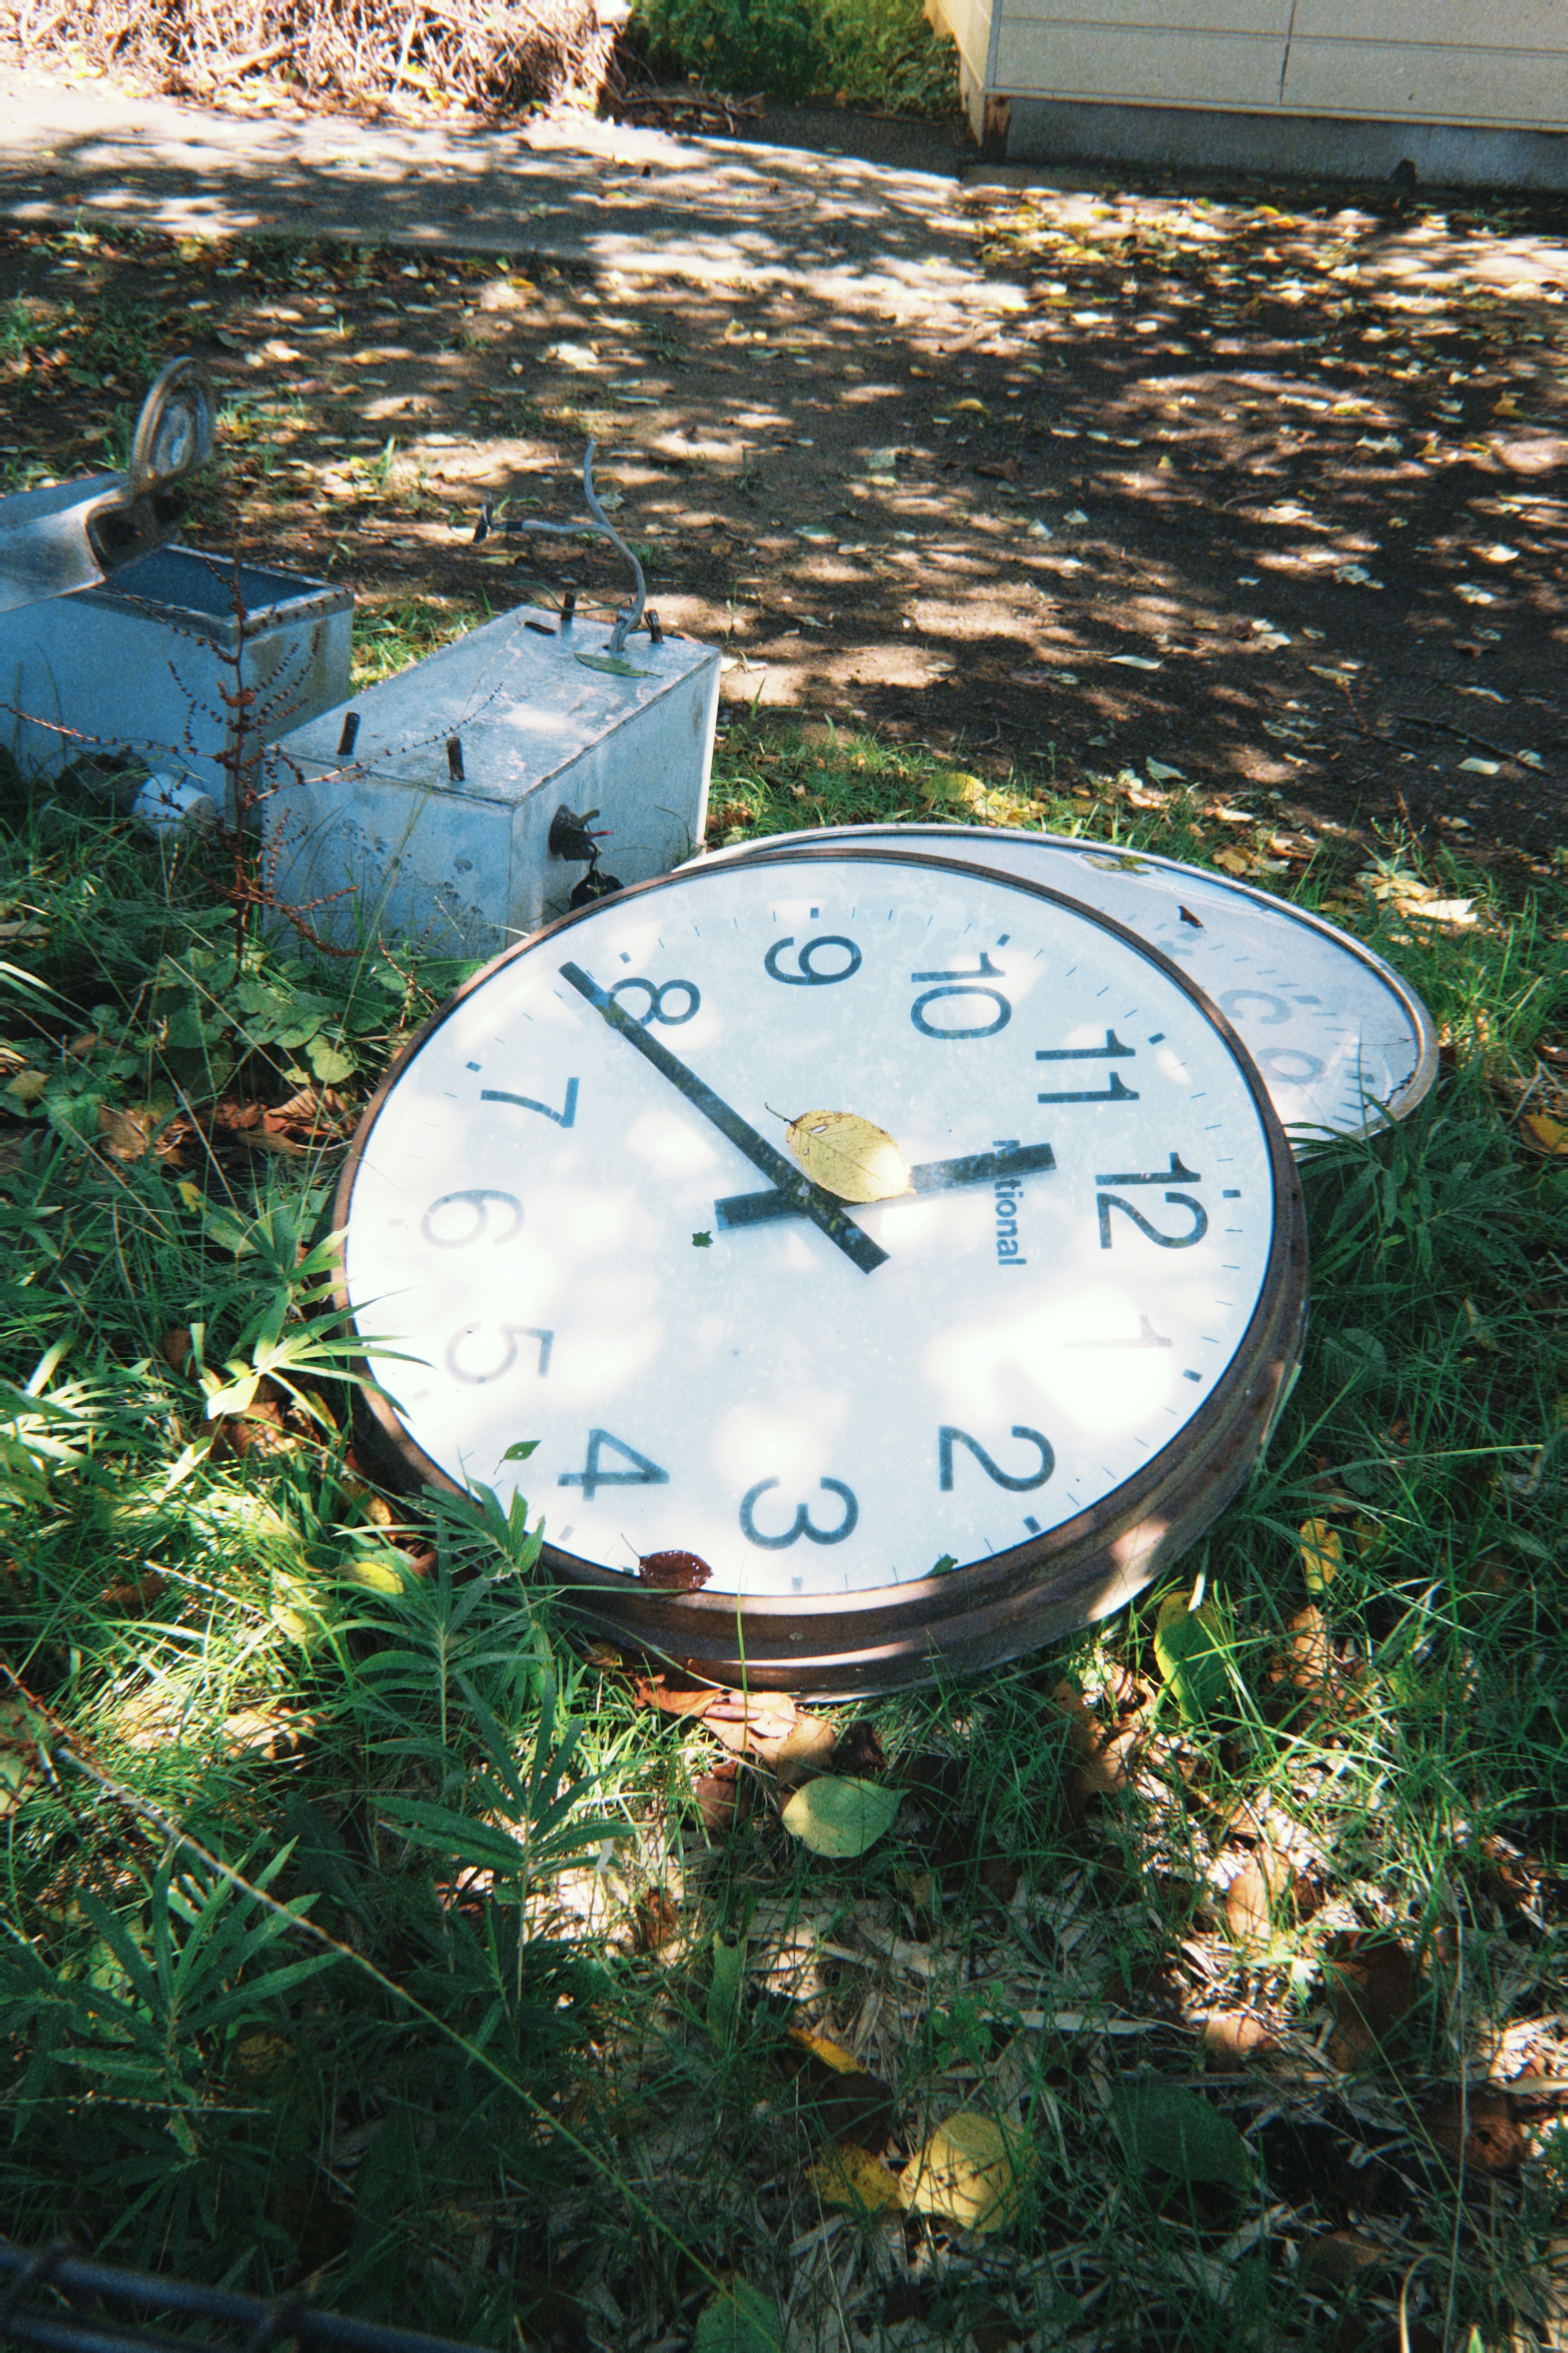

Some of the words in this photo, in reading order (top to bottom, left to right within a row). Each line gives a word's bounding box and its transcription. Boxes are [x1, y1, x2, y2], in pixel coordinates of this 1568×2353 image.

[764, 935, 861, 985] 9
[607, 977, 701, 1031] 8
[911, 952, 1012, 1040] 10
[1035, 1029, 1140, 1104] 11
[481, 1077, 579, 1128] 7
[421, 1189, 526, 1249] 6
[993, 1140, 1027, 1265] Ntional
[1095, 1152, 1208, 1250] 12
[444, 1320, 555, 1384] 5
[1063, 1314, 1172, 1348] 1
[557, 1428, 670, 1502] 4
[938, 1425, 1056, 1492] 2
[739, 1476, 859, 1551] 3
